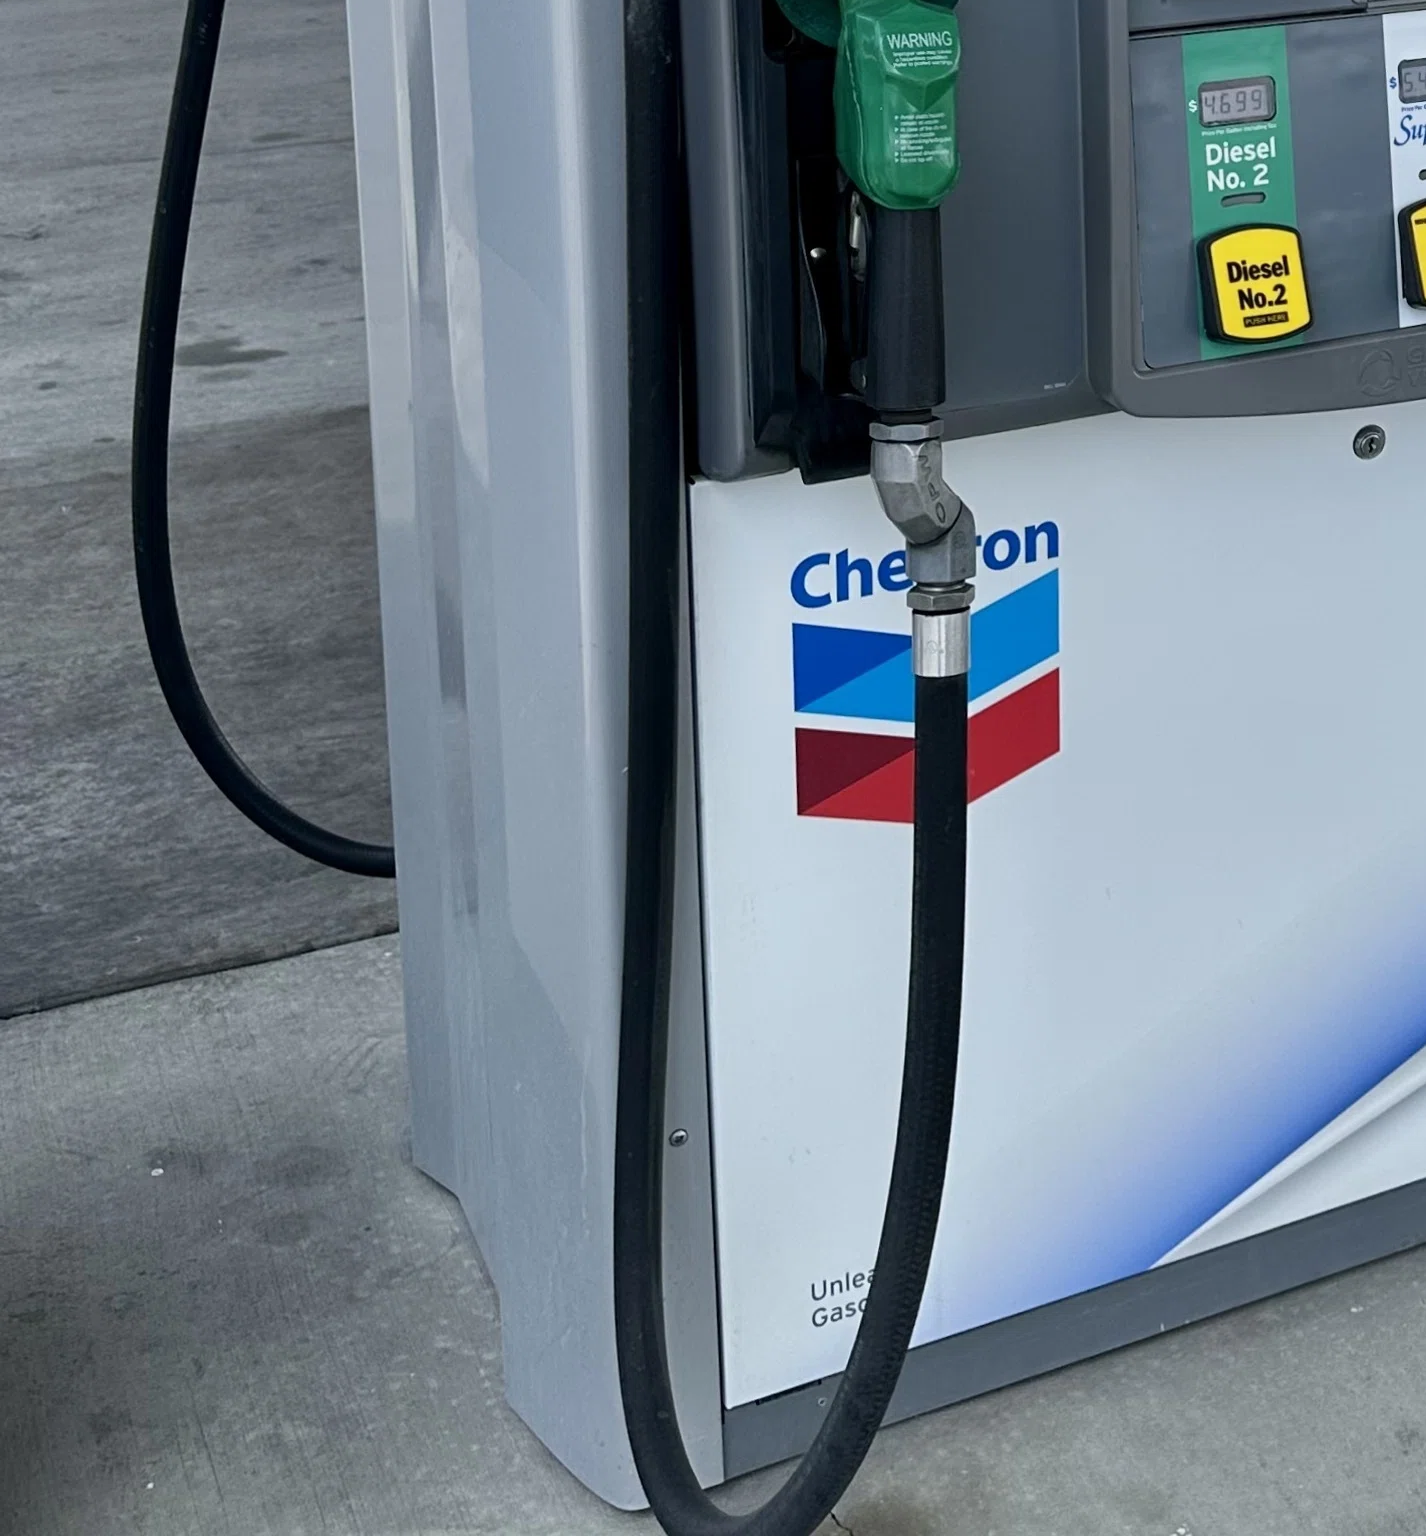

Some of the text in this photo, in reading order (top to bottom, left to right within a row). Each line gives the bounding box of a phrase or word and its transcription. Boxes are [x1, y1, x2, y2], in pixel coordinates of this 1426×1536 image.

[887, 31, 952, 49] WARNING
[1206, 136, 1276, 165] Diesel
[1207, 165, 1269, 192] No. 2
[1226, 255, 1289, 284] Diesel
[1238, 283, 1288, 311] No.2
[790, 520, 1059, 608] Cheon
